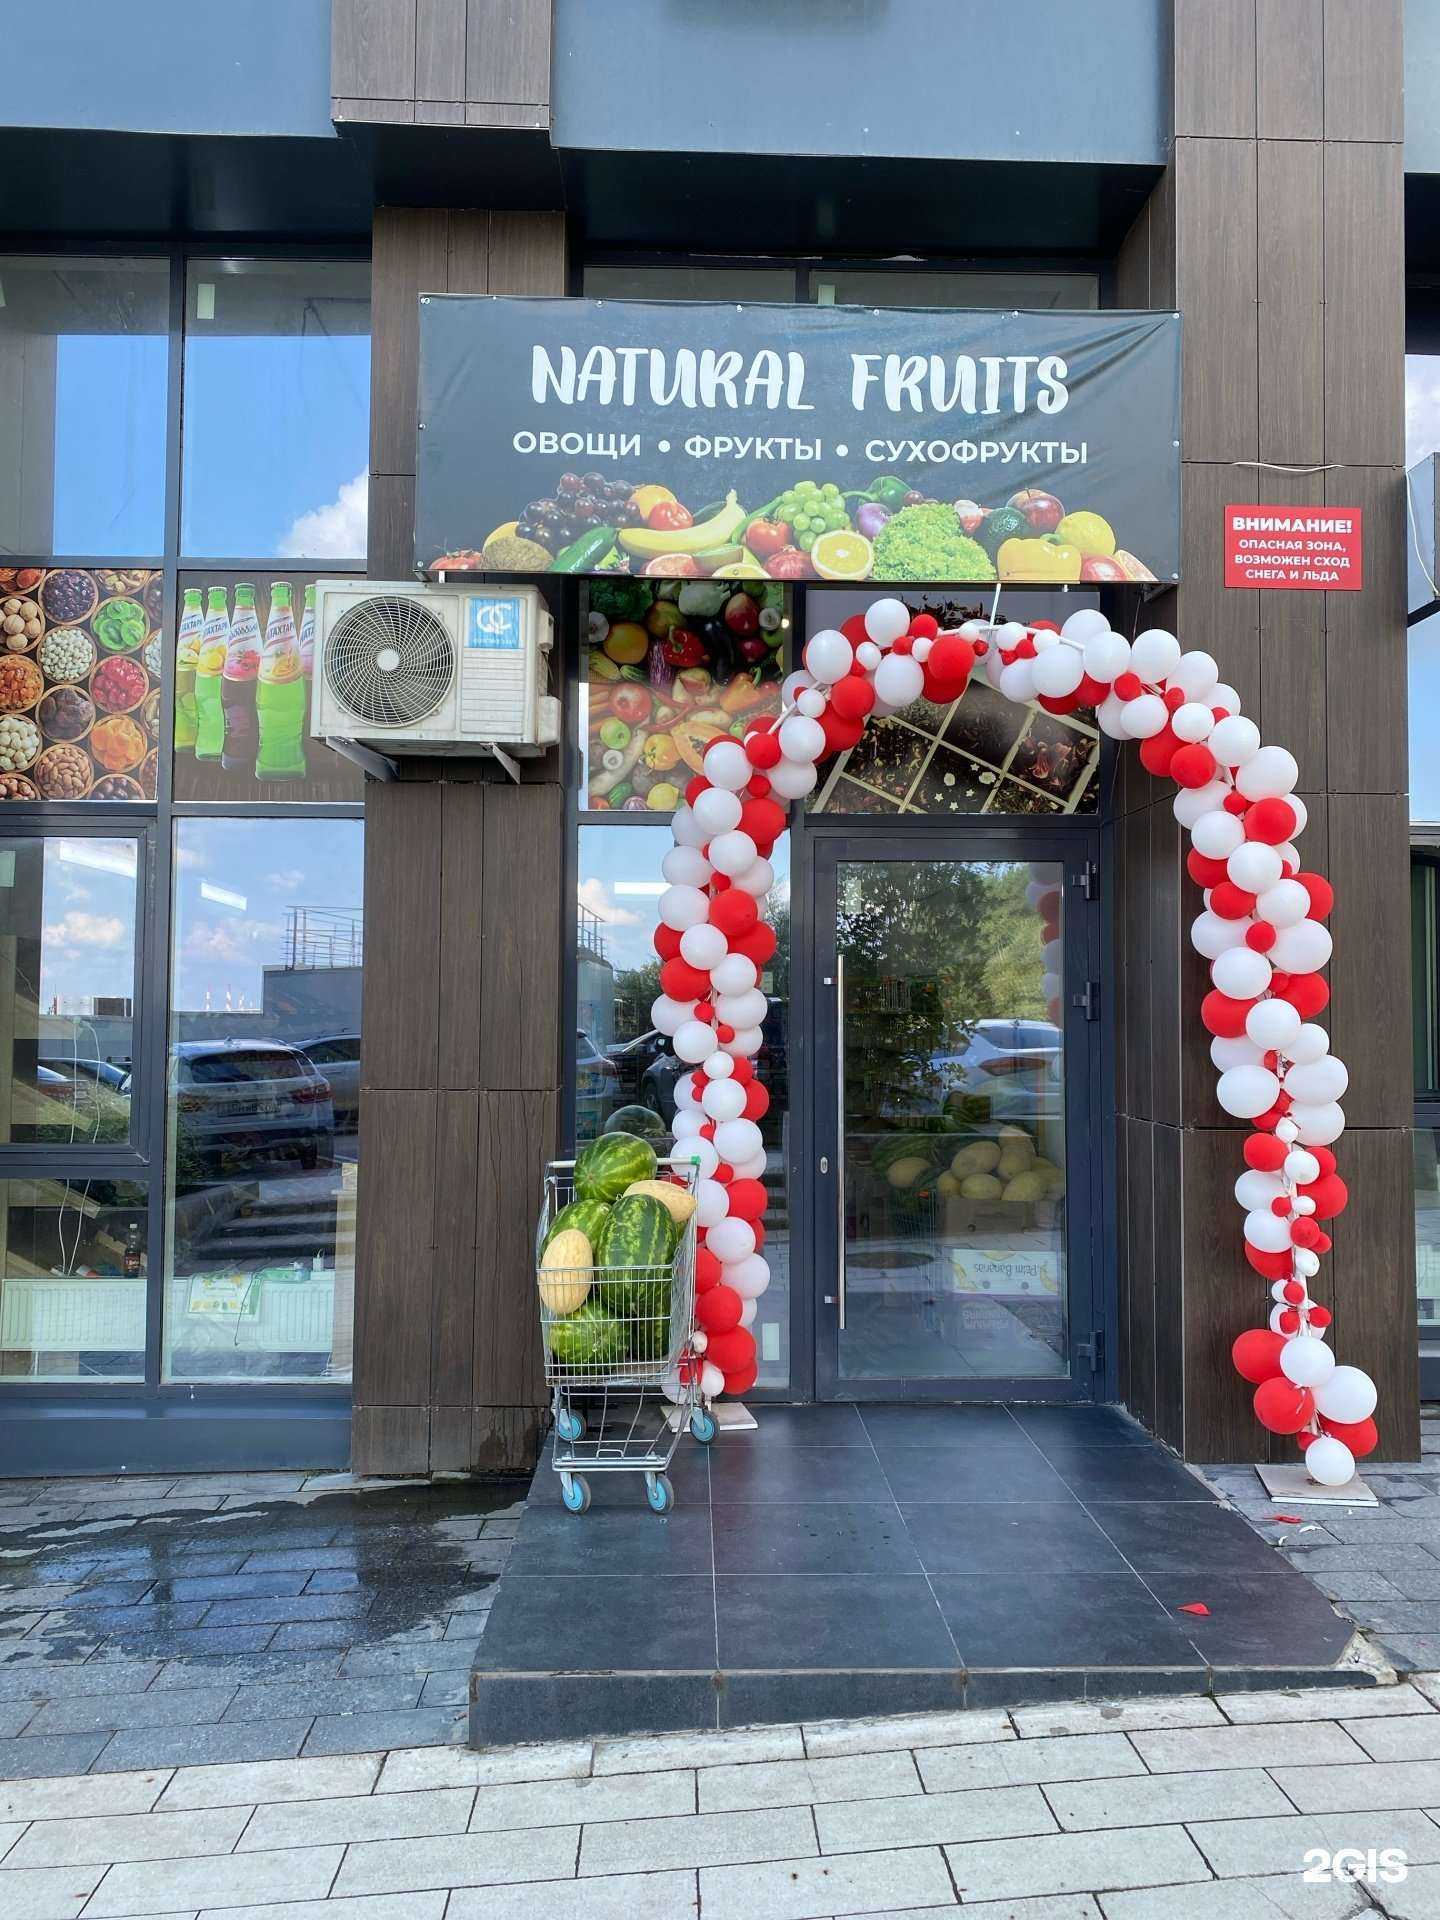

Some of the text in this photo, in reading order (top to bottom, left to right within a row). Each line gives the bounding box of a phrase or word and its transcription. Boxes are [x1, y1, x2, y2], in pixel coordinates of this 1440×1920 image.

[532, 345, 1069, 414] NATURAL FRUITS
[512, 431, 1088, 464] ОВОЩИ ФРУКТЫ СУХОФРУКТЫ
[1232, 516, 1353, 534] ВНИМАНИЕ!
[1239, 539, 1346, 553] ОПАСНАЯ ЗОНА,
[1234, 554, 1351, 568] ВОЗМОЖЕН СХОД
[1245, 569, 1340, 582] СНЕГА И ЛЬДА
